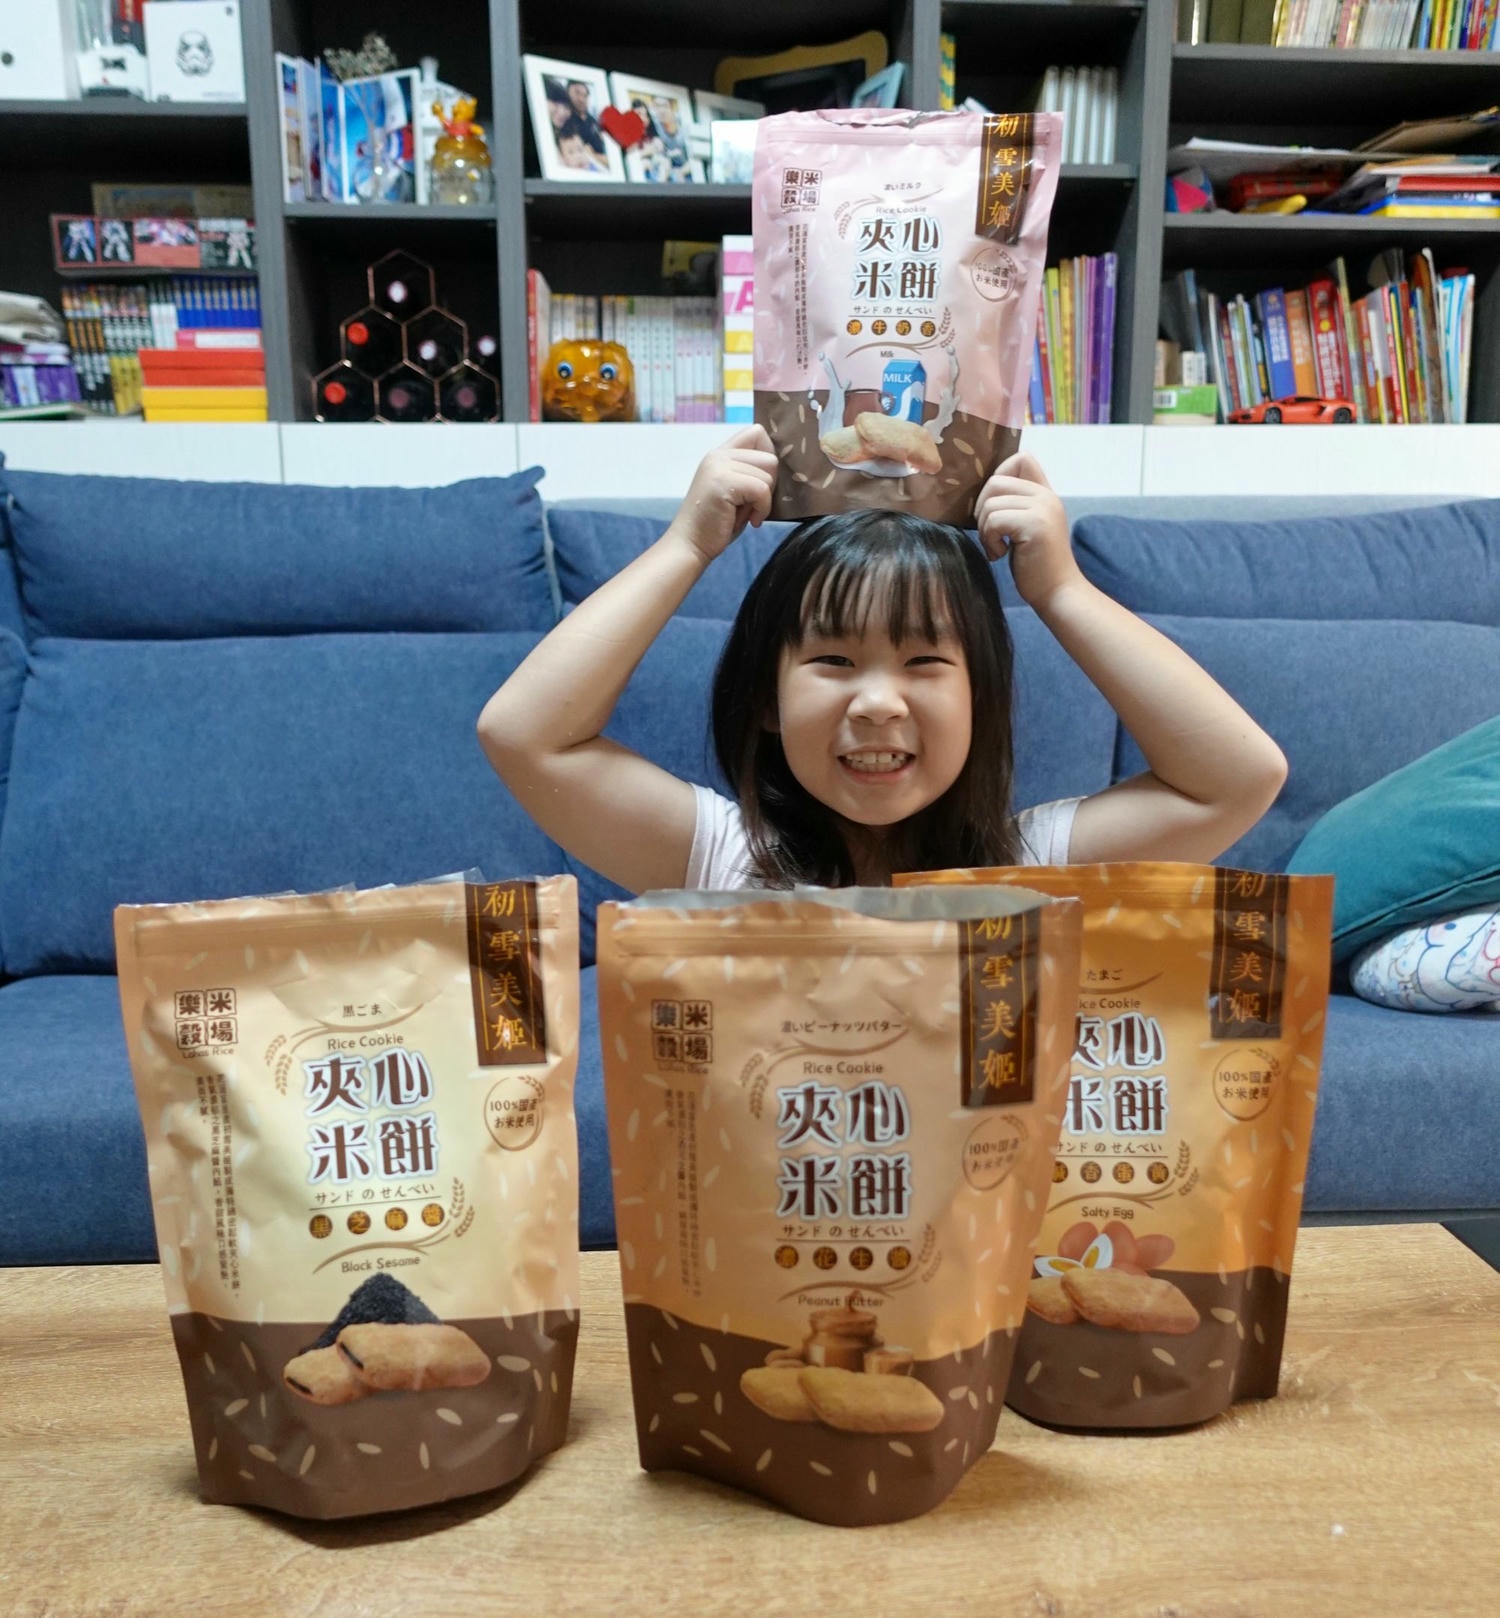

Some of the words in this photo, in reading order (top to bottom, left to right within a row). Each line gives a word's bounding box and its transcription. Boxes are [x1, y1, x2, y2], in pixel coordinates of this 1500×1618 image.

[860, 218, 939, 253] 夾心
[855, 261, 936, 298] 米餅
[880, 350, 894, 358] Milk
[884, 373, 912, 383] MILK
[1079, 999, 1096, 1009] ice
[1099, 998, 1141, 1009] Cookie
[327, 1038, 356, 1050] Rice
[359, 1034, 404, 1048] Cookie
[213, 1046, 234, 1056] Rice
[803, 1061, 833, 1074] Rice
[836, 1061, 883, 1074] Cookie
[309, 1053, 429, 1113] 夾心
[1067, 1080, 1165, 1131] 米餅
[779, 1085, 906, 1145] 夾心
[313, 1117, 436, 1179] 米餅
[778, 1157, 908, 1218] 米餅
[1081, 1206, 1109, 1218] Salty
[1113, 1207, 1134, 1219] Egg
[341, 1260, 372, 1273] Black
[376, 1256, 421, 1270] Sesame
[797, 1295, 841, 1306] Peanut
